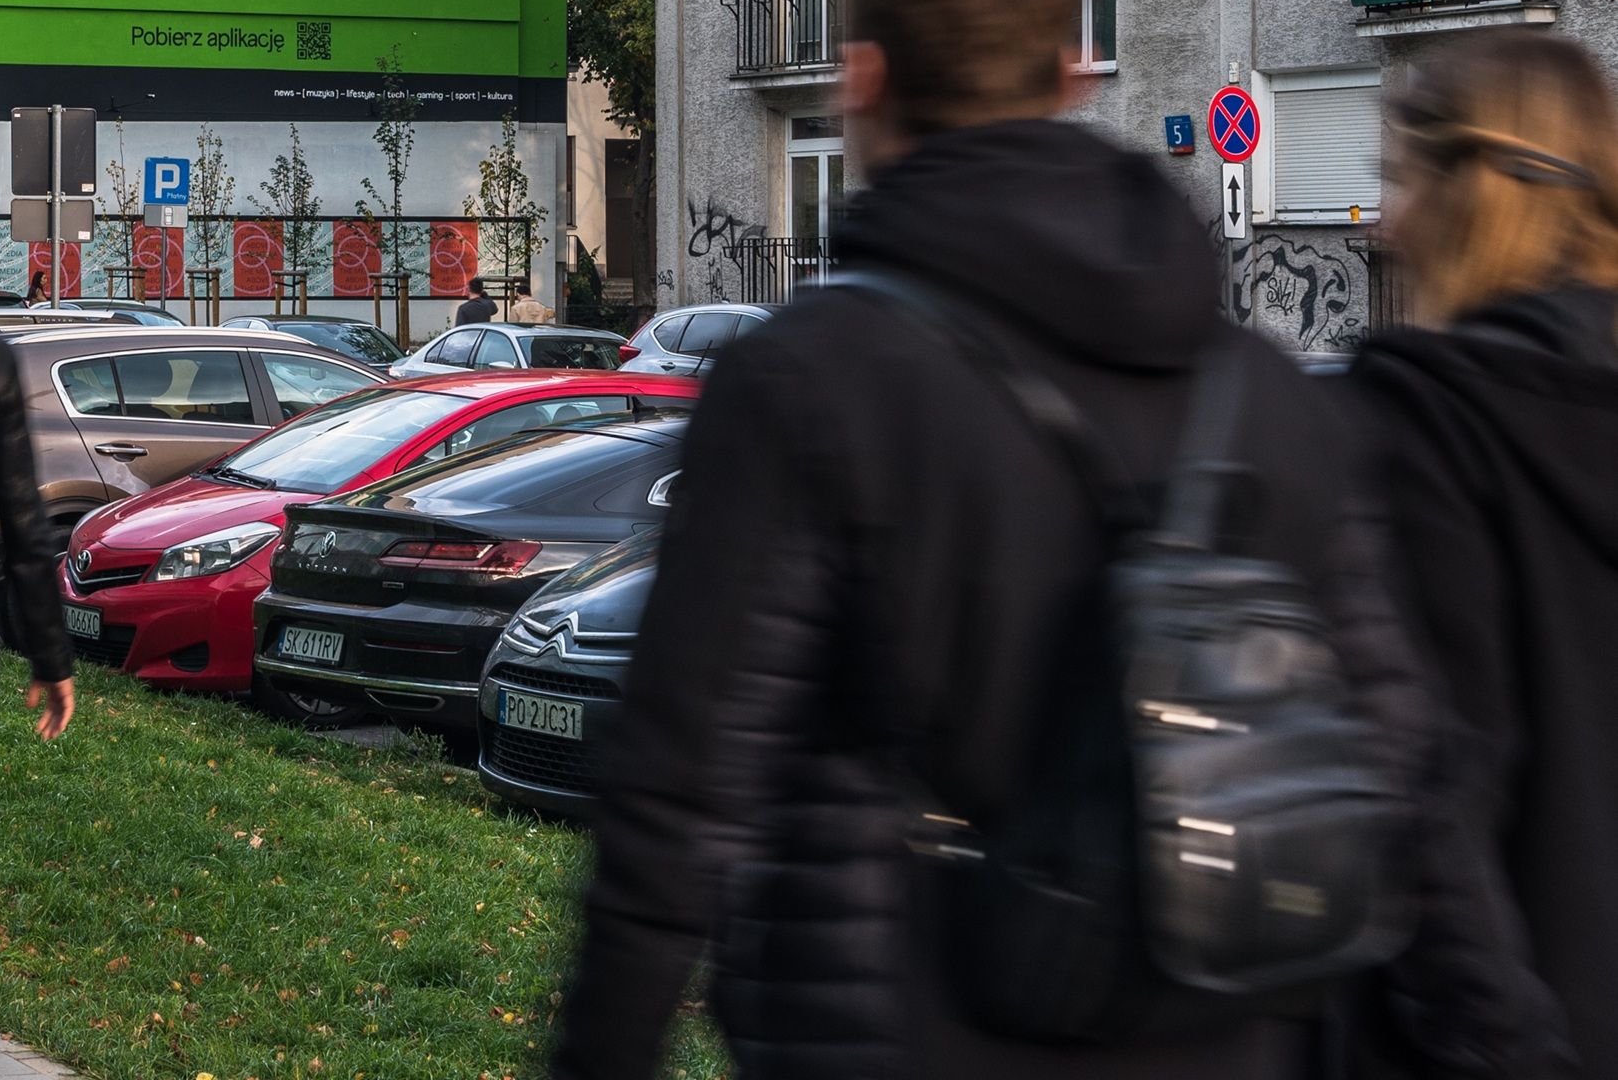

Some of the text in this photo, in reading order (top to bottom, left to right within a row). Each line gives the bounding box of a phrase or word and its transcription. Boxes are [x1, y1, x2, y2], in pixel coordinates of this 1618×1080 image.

[132, 26, 285, 52] Pobierz aplikację
[274, 89, 513, 101] news muzyka lifestyle tech gaming sport kultura
[1173, 125, 1182, 144] 5
[155, 163, 180, 199] P
[284, 629, 342, 659] SK 611RV
[508, 695, 526, 725] PO
[530, 700, 576, 736] 2JC31
